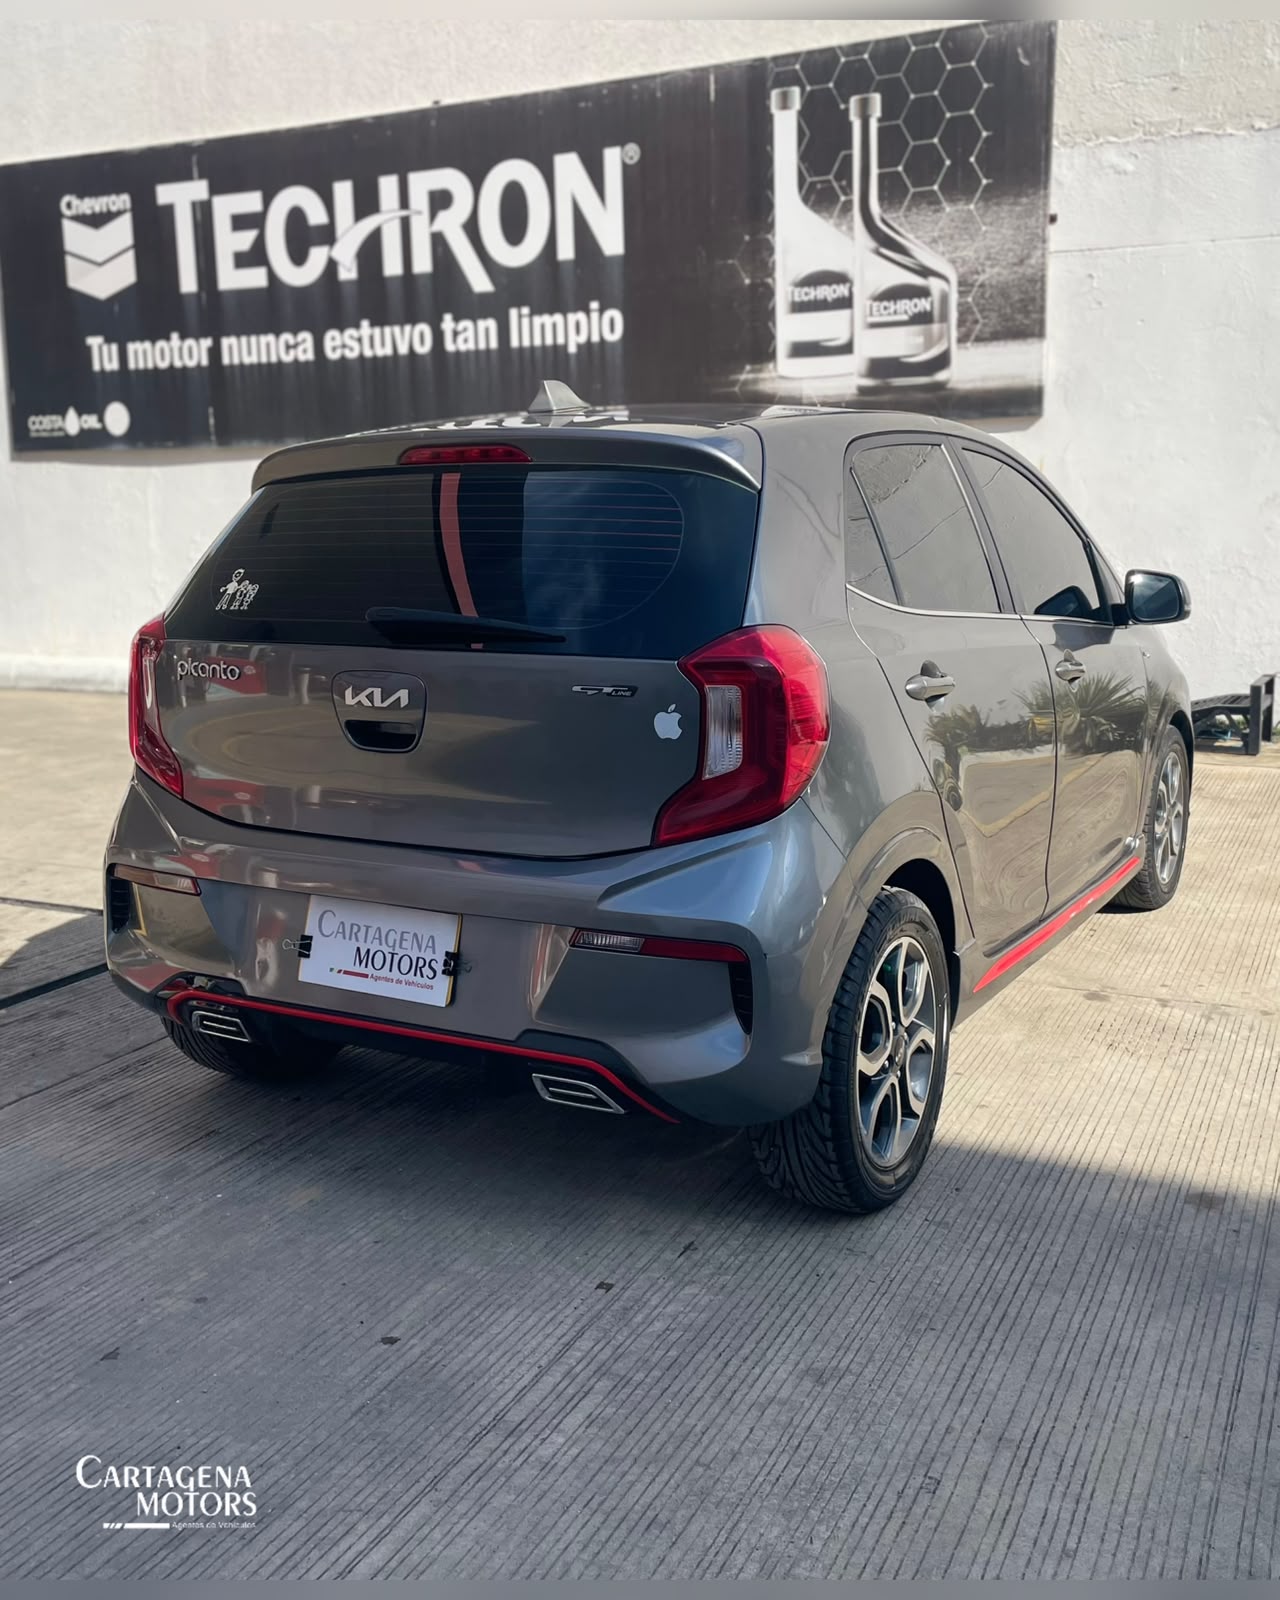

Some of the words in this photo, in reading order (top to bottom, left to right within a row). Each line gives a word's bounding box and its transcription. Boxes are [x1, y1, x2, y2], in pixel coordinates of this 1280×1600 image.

[60, 192, 132, 217] Chevron
[86, 335, 120, 372] Tu
[126, 331, 213, 370] motor
[220, 330, 315, 366] nunca
[323, 319, 433, 360] estuvo
[441, 313, 499, 352] tan
[509, 300, 625, 354] limpio
[177, 659, 241, 681] picanto
[345, 685, 409, 708] KIA
[353, 946, 439, 981] MOTORS
[370, 973, 394, 983] Agentes
